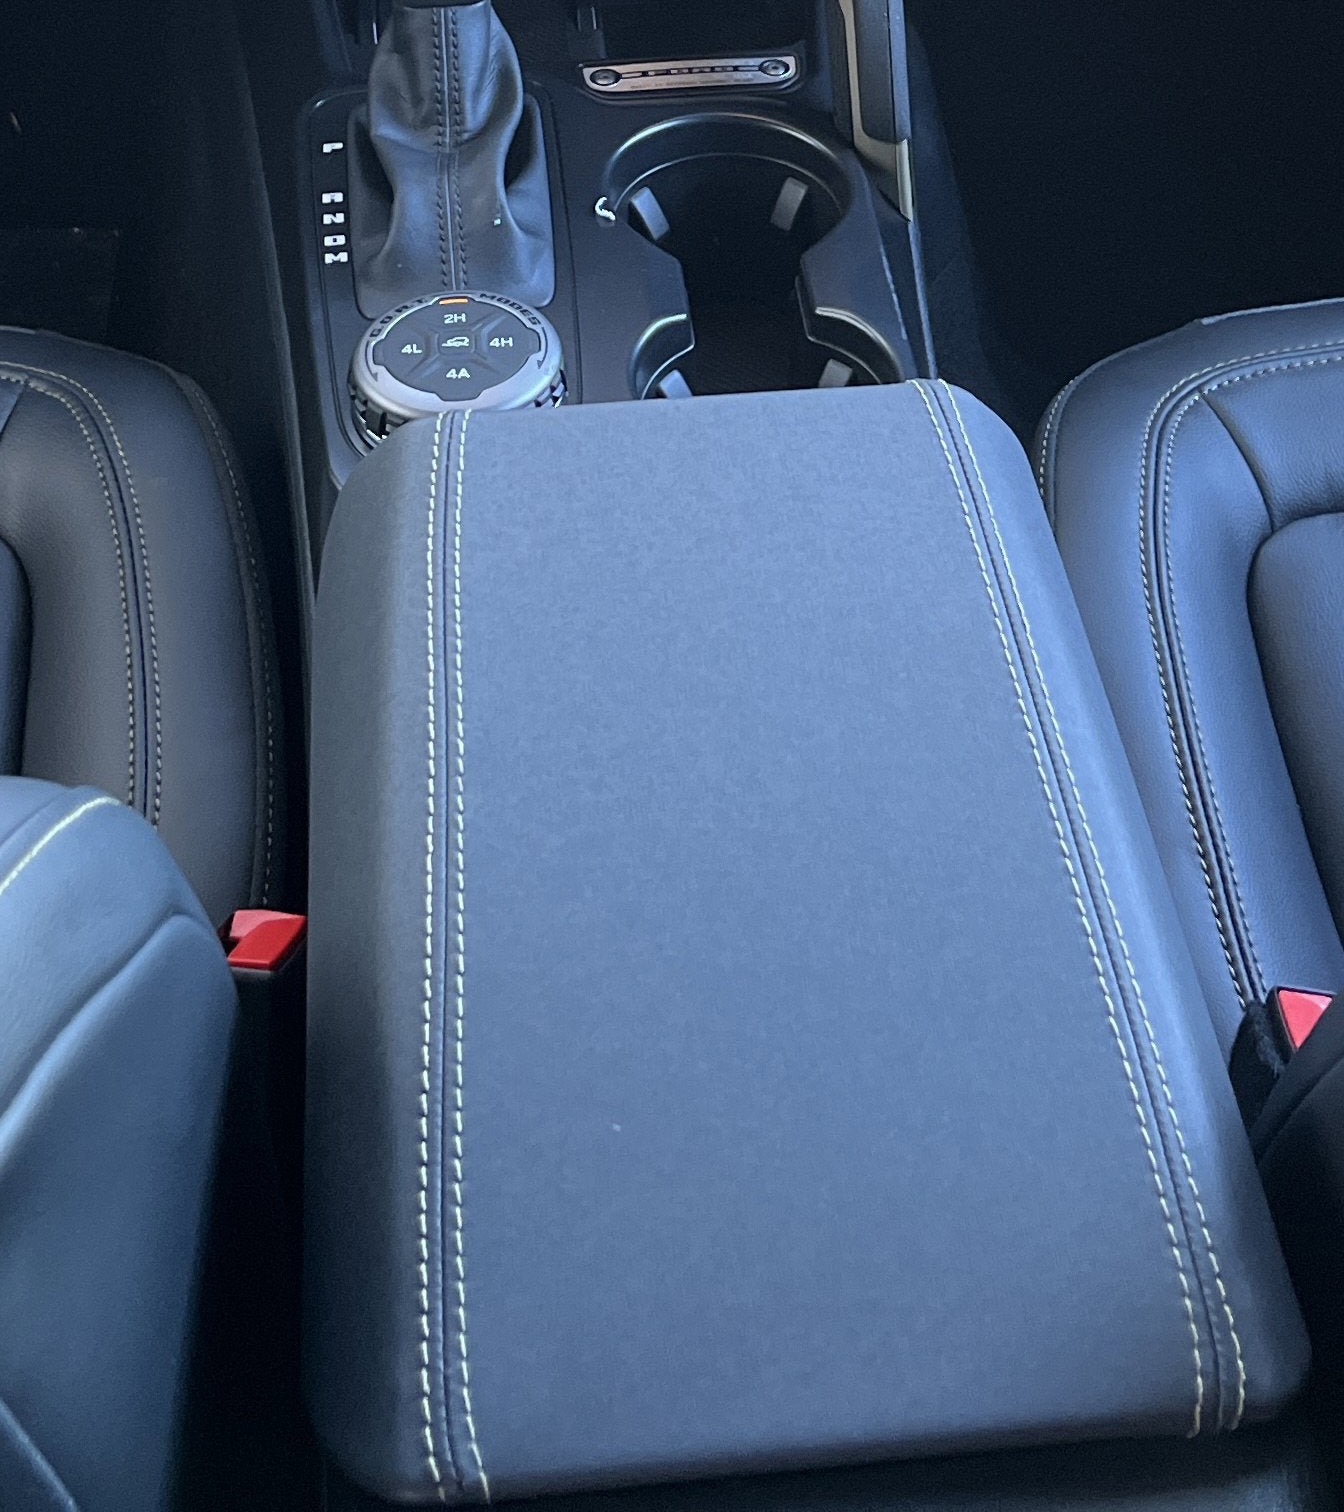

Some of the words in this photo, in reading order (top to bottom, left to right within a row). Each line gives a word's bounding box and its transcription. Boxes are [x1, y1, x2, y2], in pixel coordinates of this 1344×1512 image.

[322, 212, 345, 224] N
[324, 251, 348, 265] M
[479, 292, 542, 326] MODES
[443, 313, 467, 324] 2H
[489, 336, 514, 348] 4H
[401, 344, 423, 354] 4L
[445, 368, 471, 379] 4A
